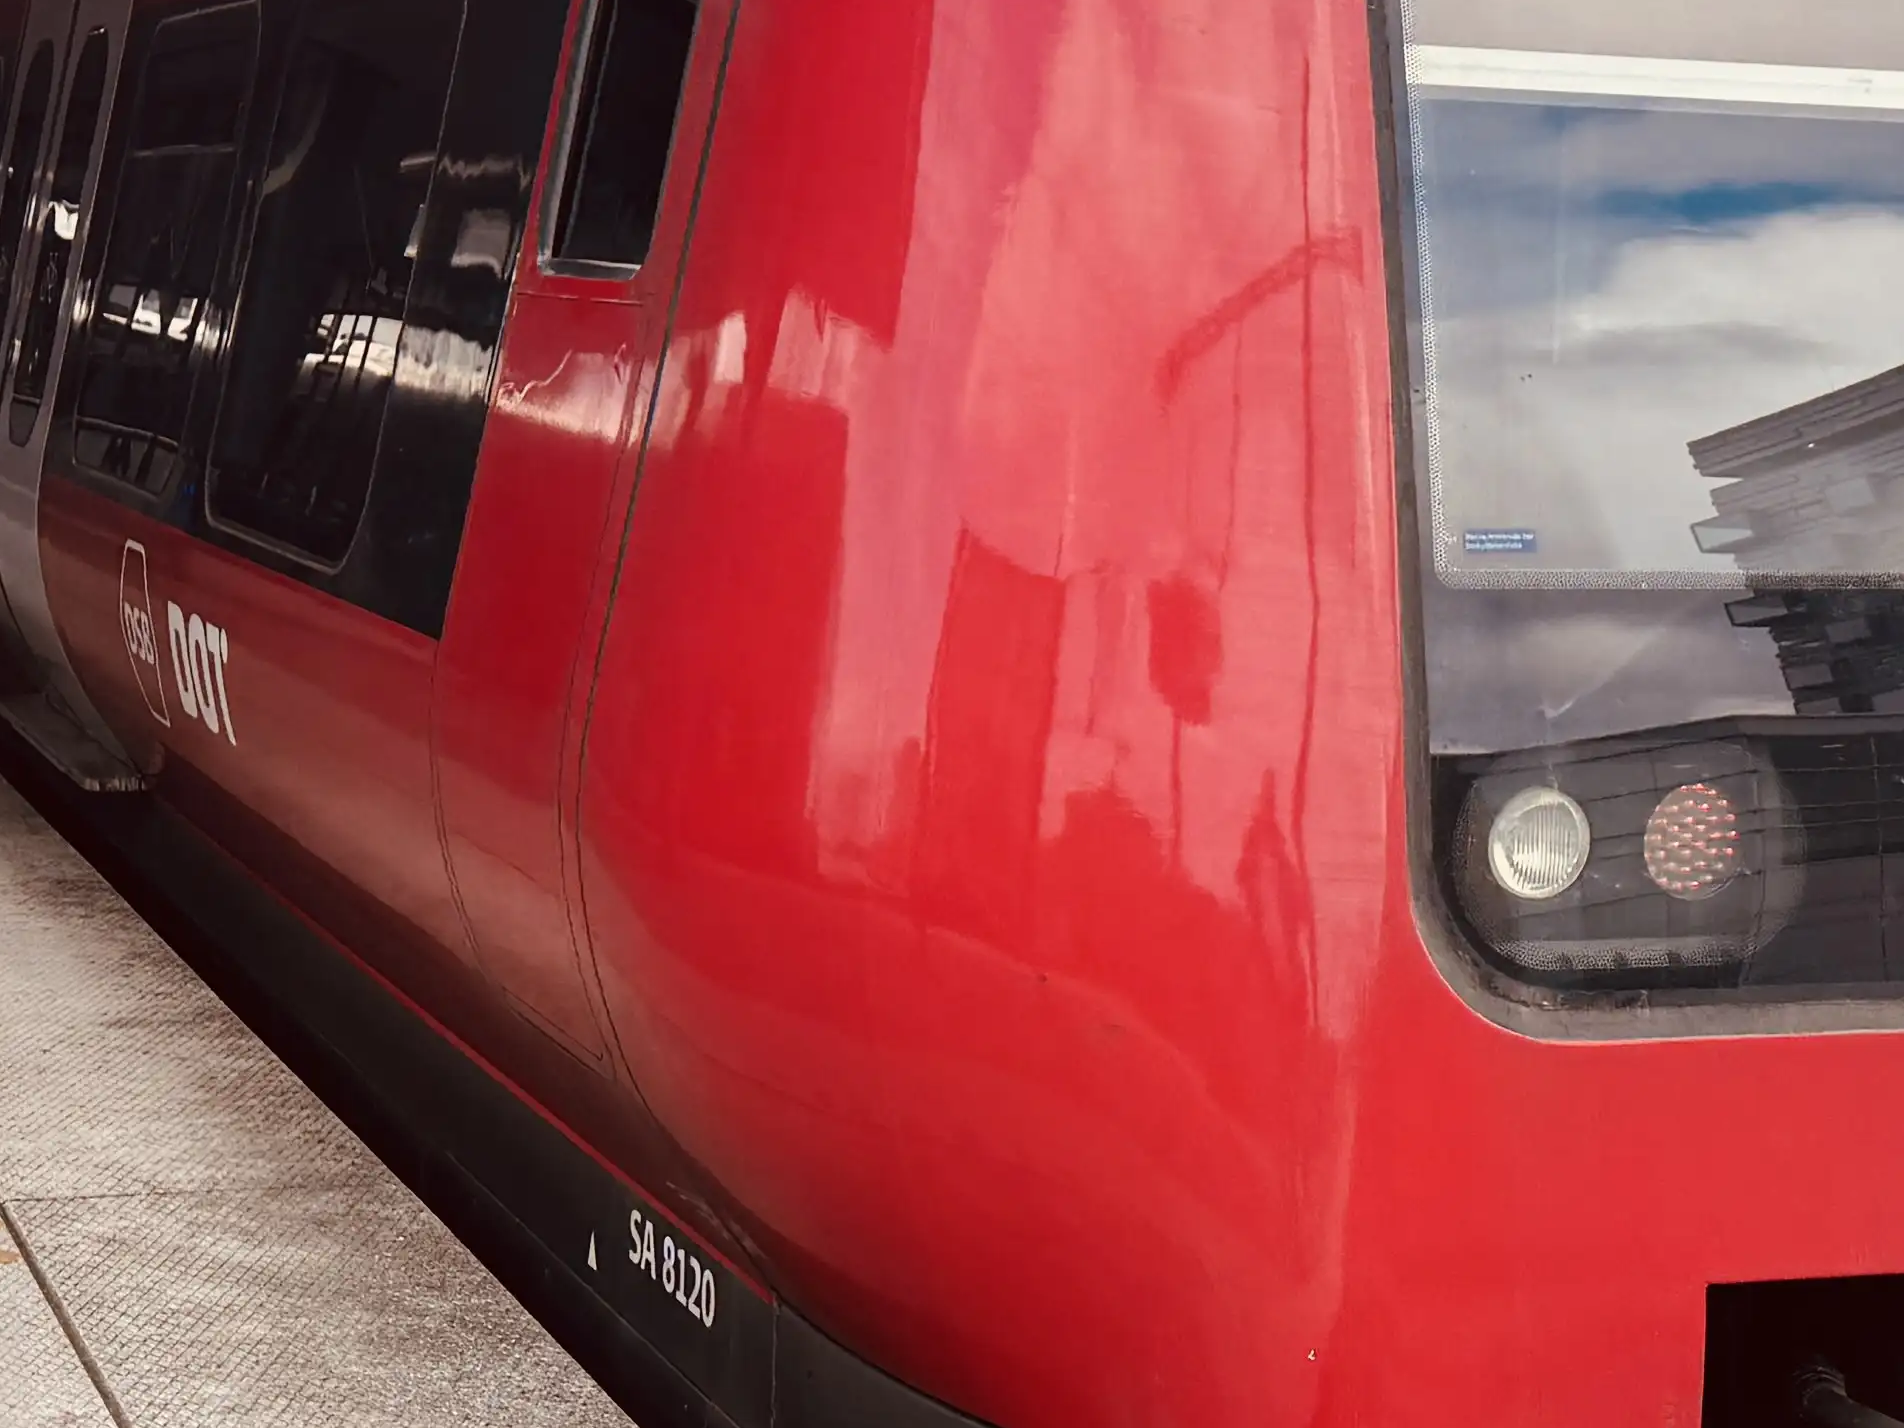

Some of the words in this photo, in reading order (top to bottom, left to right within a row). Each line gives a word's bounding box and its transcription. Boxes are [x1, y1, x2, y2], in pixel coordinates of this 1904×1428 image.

[123, 600, 155, 665] DSB
[628, 1209, 656, 1280] SA
[662, 1235, 716, 1328] 8120
